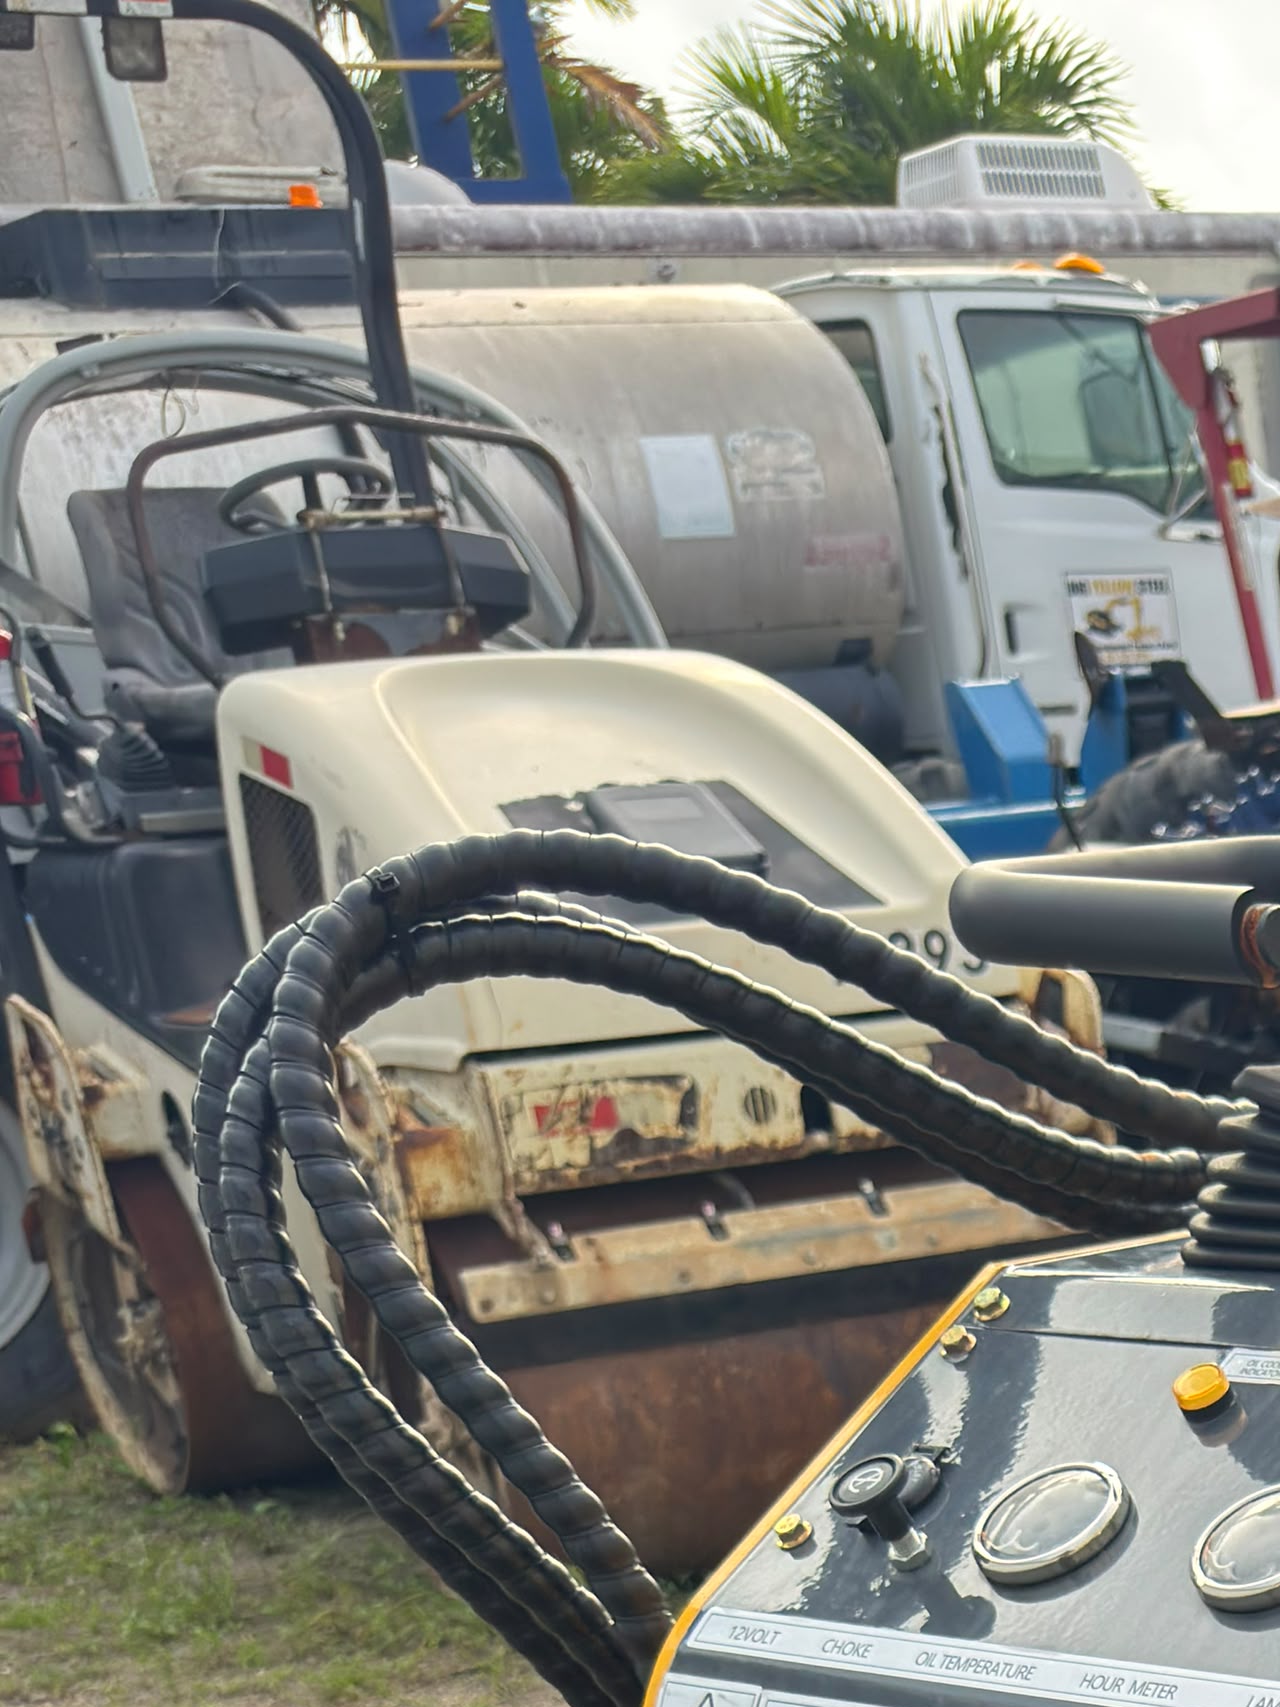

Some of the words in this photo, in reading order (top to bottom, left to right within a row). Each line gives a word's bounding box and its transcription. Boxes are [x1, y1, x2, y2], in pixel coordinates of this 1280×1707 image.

[728, 1625, 782, 1646] 12VOLT
[821, 1638, 873, 1659] CHOKE
[915, 1651, 937, 1668] OIL
[938, 1653, 1037, 1681] TEMPERATURE
[1079, 1673, 1126, 1693] HOUR
[1128, 1679, 1179, 1700] METER
